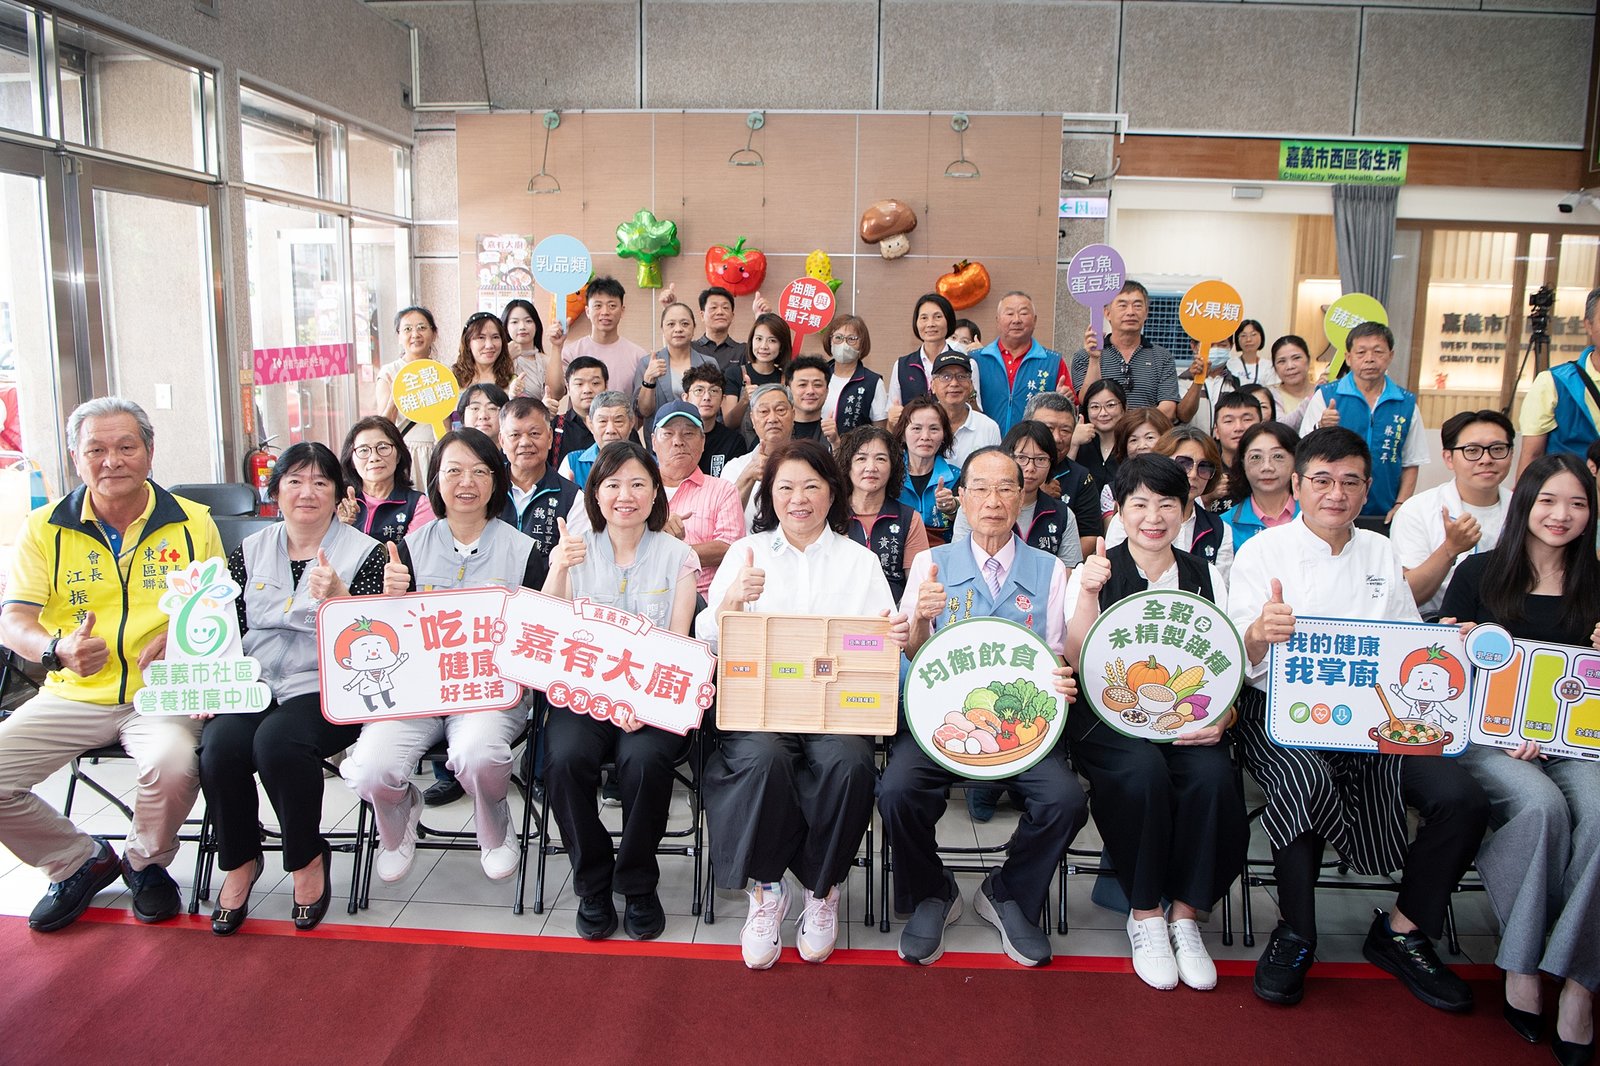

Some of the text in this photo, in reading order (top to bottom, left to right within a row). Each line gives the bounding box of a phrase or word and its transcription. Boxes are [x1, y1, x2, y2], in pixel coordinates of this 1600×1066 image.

[1285, 146, 1401, 171] 嘉義市西區衛生所
[1284, 171, 1401, 182] Chiayi City West Health Center
[536, 255, 588, 273] 乳品類
[1079, 255, 1112, 274] 豆魚
[791, 281, 816, 298] 油脂
[1071, 273, 1120, 294] 蛋豆類
[787, 295, 812, 310] 堅果
[1185, 298, 1241, 322] 水果類
[785, 309, 822, 328] 種子類
[1476, 355, 1500, 364] CITY
[402, 366, 440, 392] 全穀
[399, 381, 455, 412] 雜糧類
[382, 525, 395, 538] 許
[87, 550, 104, 582] 會長
[66, 570, 89, 625] 江振章
[594, 608, 631, 627] 嘉義市
[420, 609, 496, 651] 吃出
[1108, 623, 1232, 677] 未精製雜糧
[1286, 631, 1381, 657] 我的健康
[1476, 650, 1503, 662] 乳品類
[150, 660, 253, 686] 嘉義市社區
[438, 649, 499, 681] 健康
[511, 621, 694, 705] 嘉有大廚
[918, 641, 1039, 690] 均衡飲食
[1284, 656, 1379, 688] 我掌廚
[139, 686, 264, 713] 營養推廣中心
[440, 680, 504, 703] 好生活
[552, 687, 630, 721] 系列活動
[1484, 714, 1511, 726] 水果類
[1525, 720, 1553, 732] 蔬菜類
